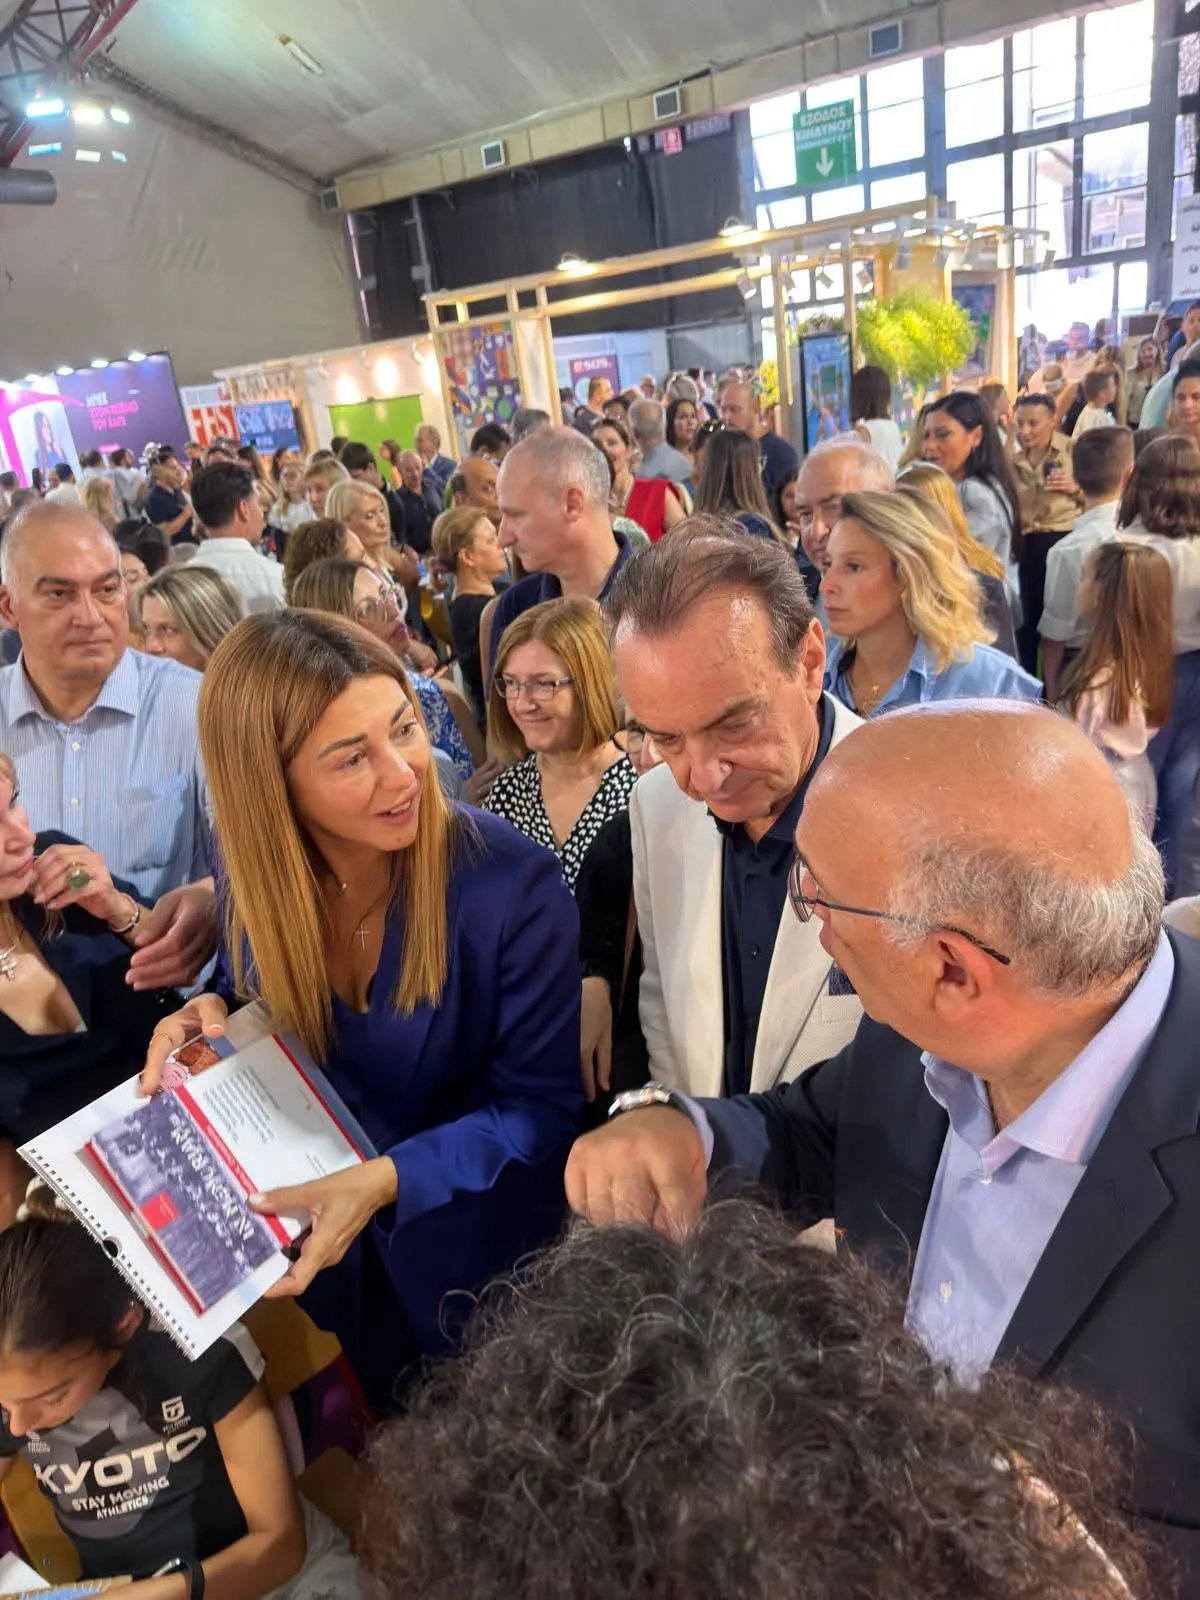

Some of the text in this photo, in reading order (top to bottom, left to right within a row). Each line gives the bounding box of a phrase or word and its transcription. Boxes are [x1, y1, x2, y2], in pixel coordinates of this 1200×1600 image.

[800, 105, 847, 127] ΕΞΟΔΟΣ
[795, 119, 852, 141] ΚΙΝΔΥΝΟΥ
[33, 1426, 207, 1495] KYOTO
[71, 1475, 170, 1512] STAY MOVING
[96, 1496, 149, 1521] ATHLETICS
